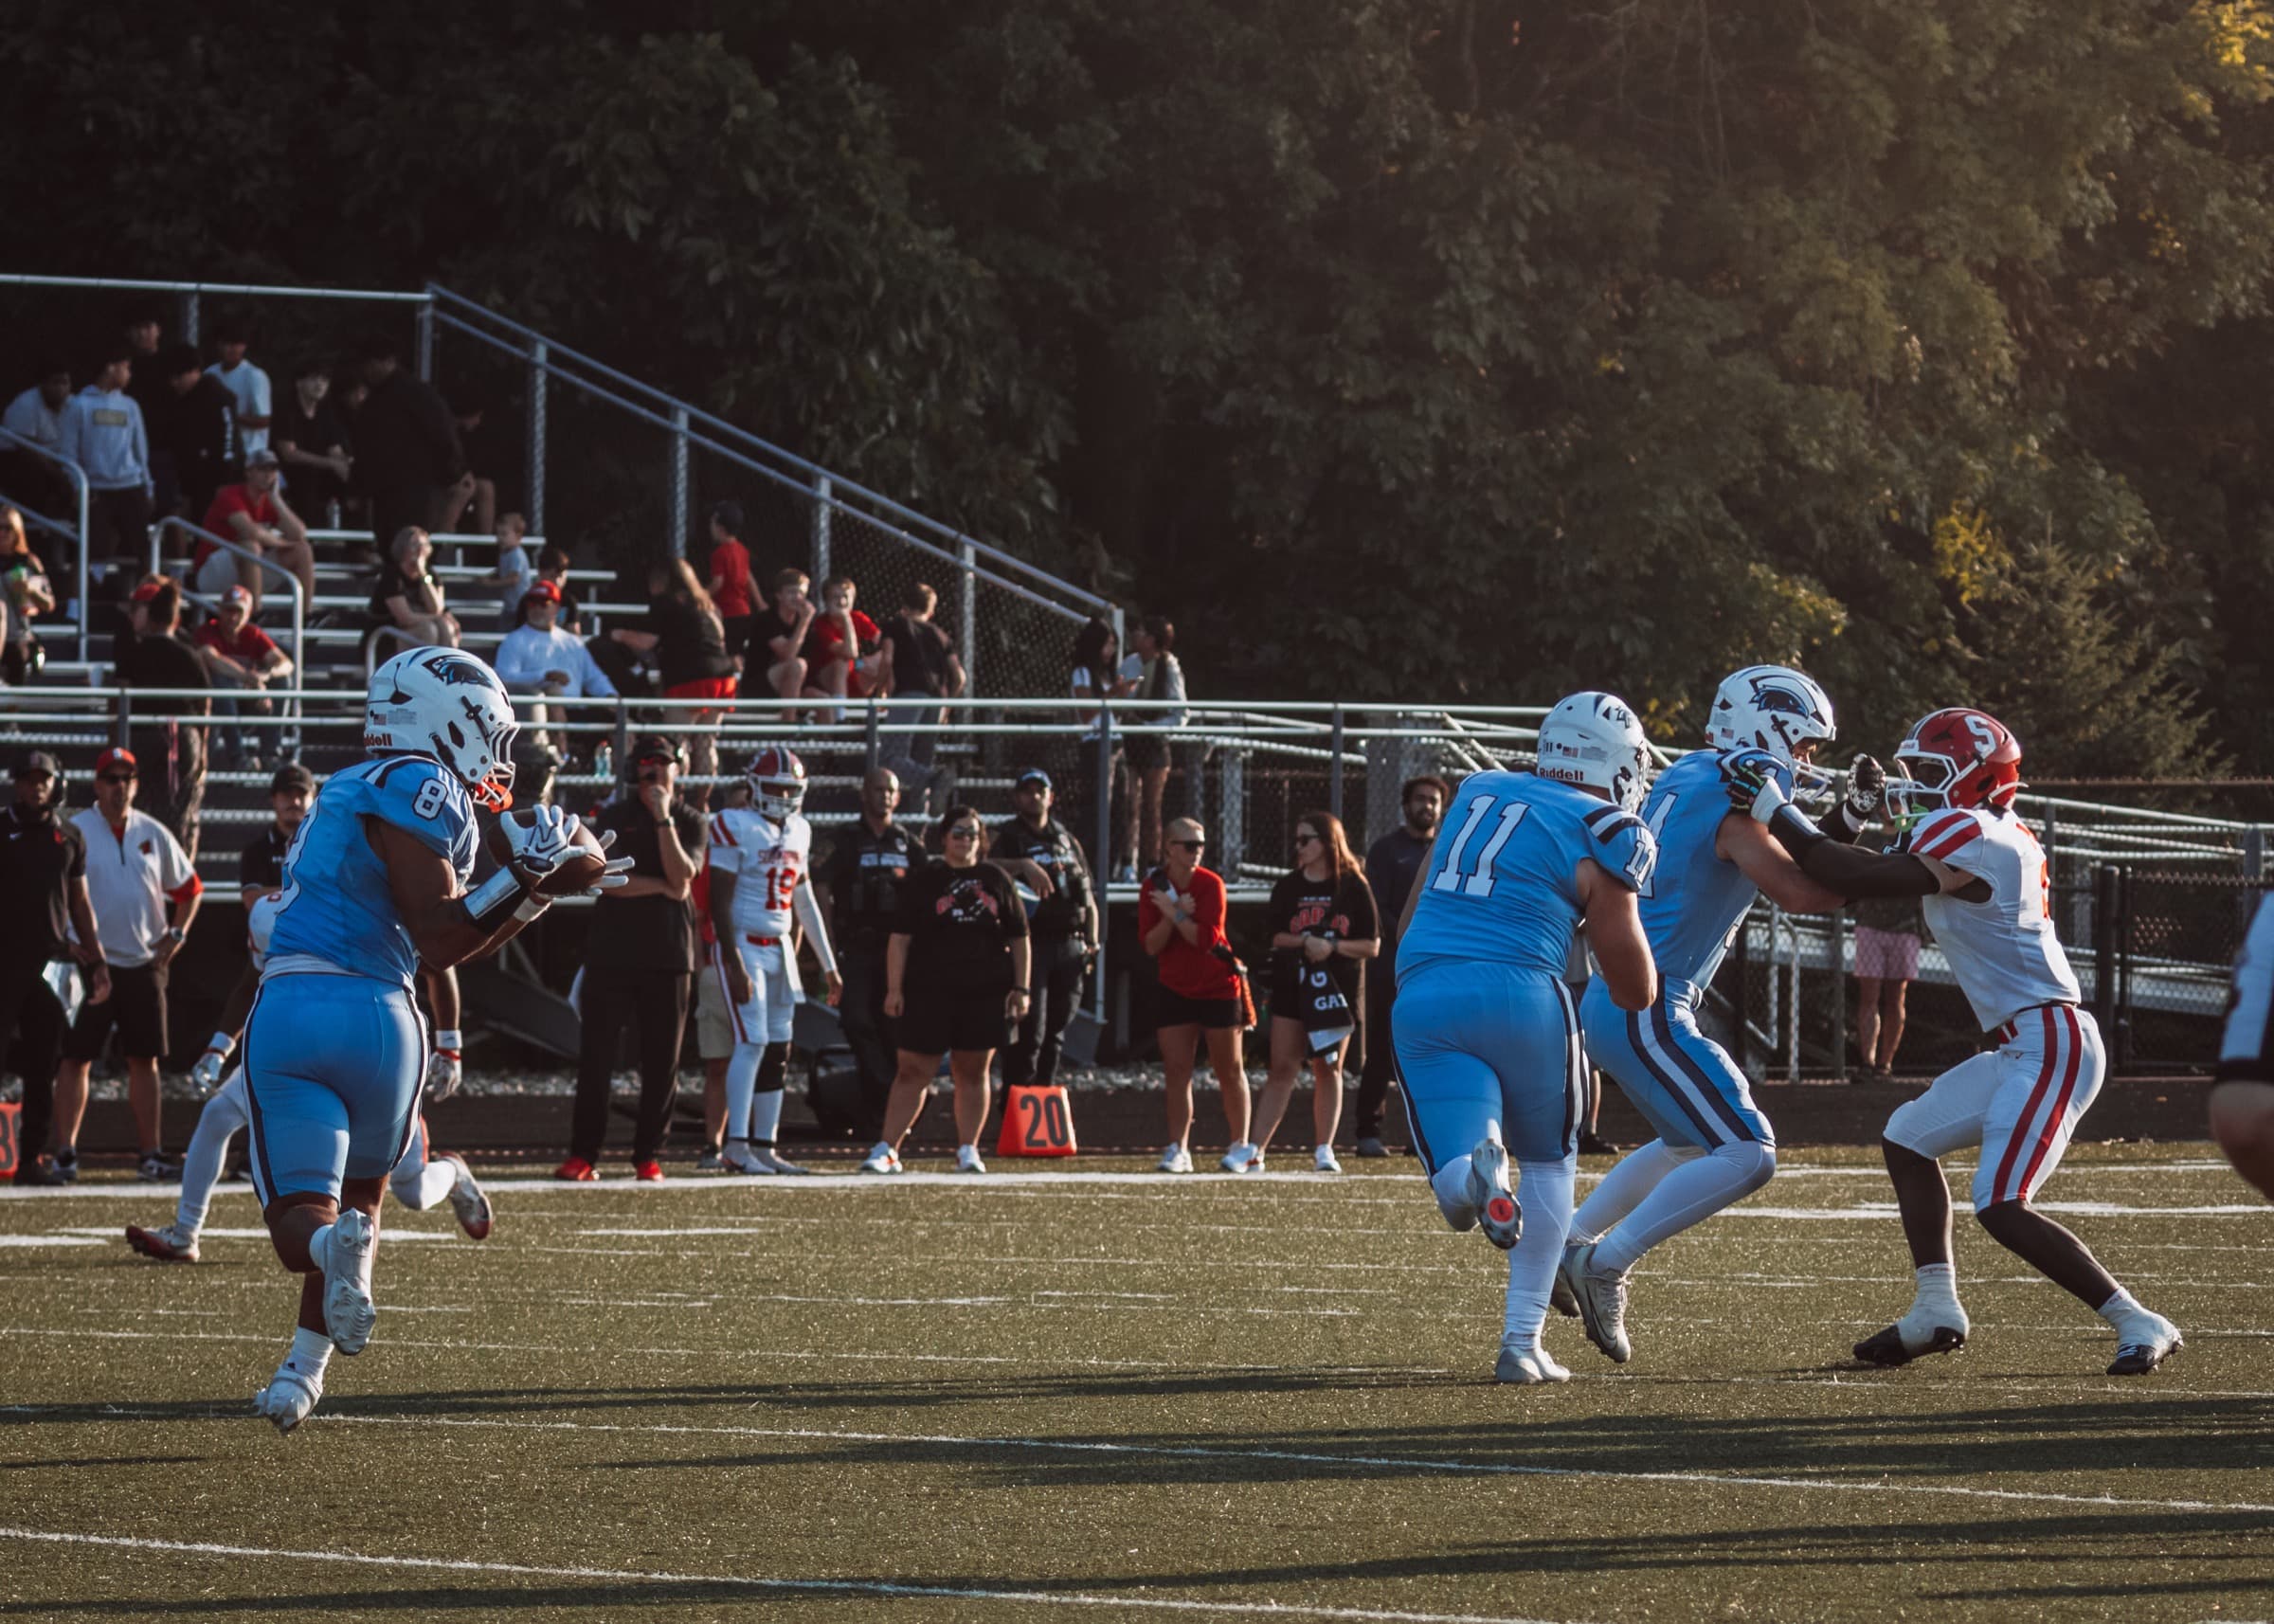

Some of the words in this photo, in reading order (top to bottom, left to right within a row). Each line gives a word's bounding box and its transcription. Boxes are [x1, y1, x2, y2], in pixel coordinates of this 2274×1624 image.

[1964, 715, 1996, 758] S
[1539, 767, 1584, 782] Riddell
[411, 777, 449, 821] 8
[1432, 793, 1532, 898] 11
[1623, 839, 1655, 889] 11
[1020, 1093, 1069, 1147] 20
